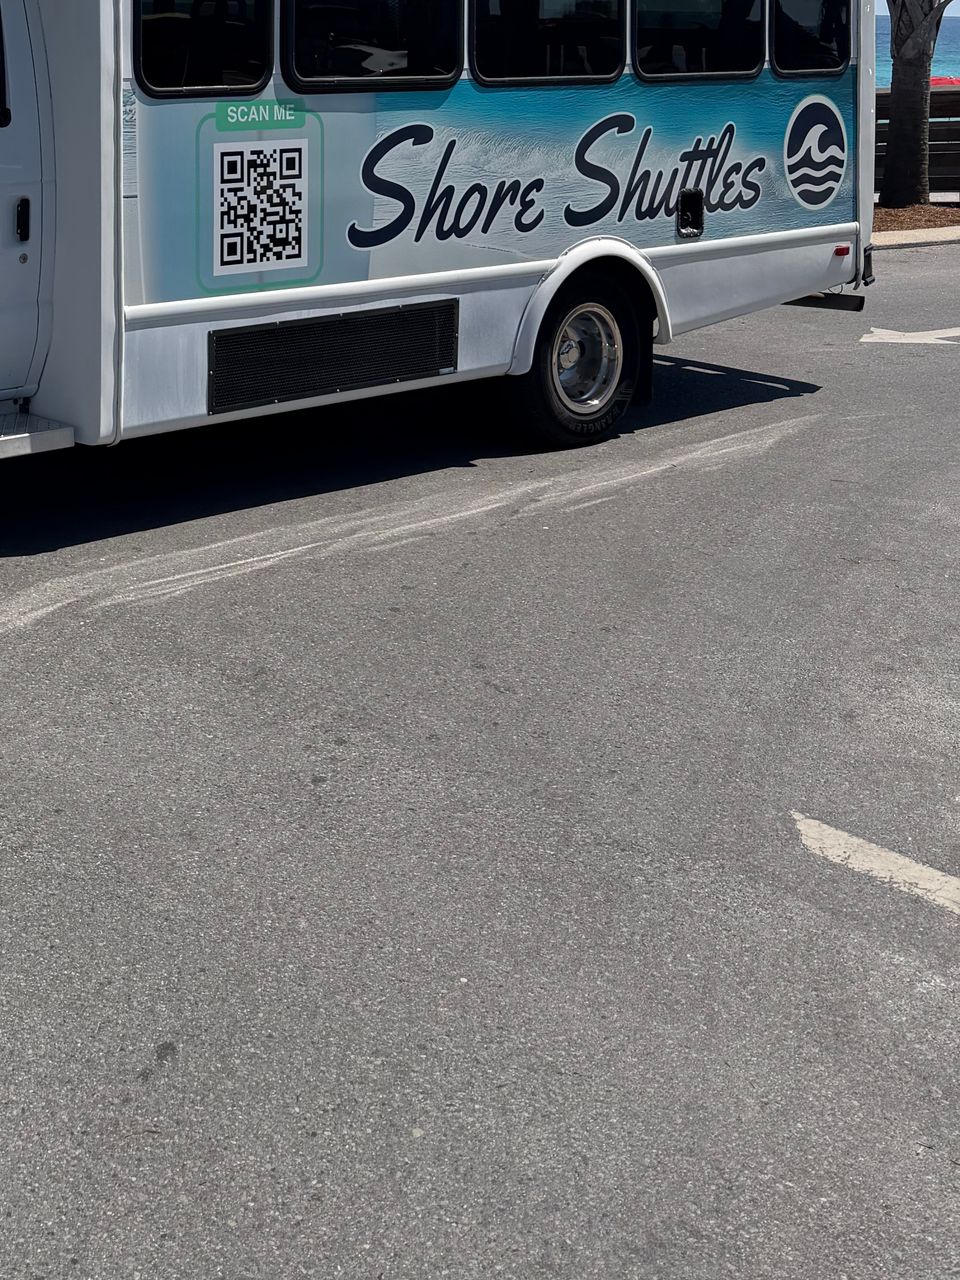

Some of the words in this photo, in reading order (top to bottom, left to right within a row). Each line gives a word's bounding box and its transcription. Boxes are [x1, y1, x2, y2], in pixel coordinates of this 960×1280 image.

[227, 105, 269, 122] SCAN
[273, 104, 295, 121] ME
[347, 123, 545, 248] Shore
[563, 112, 766, 228] Shuttles
